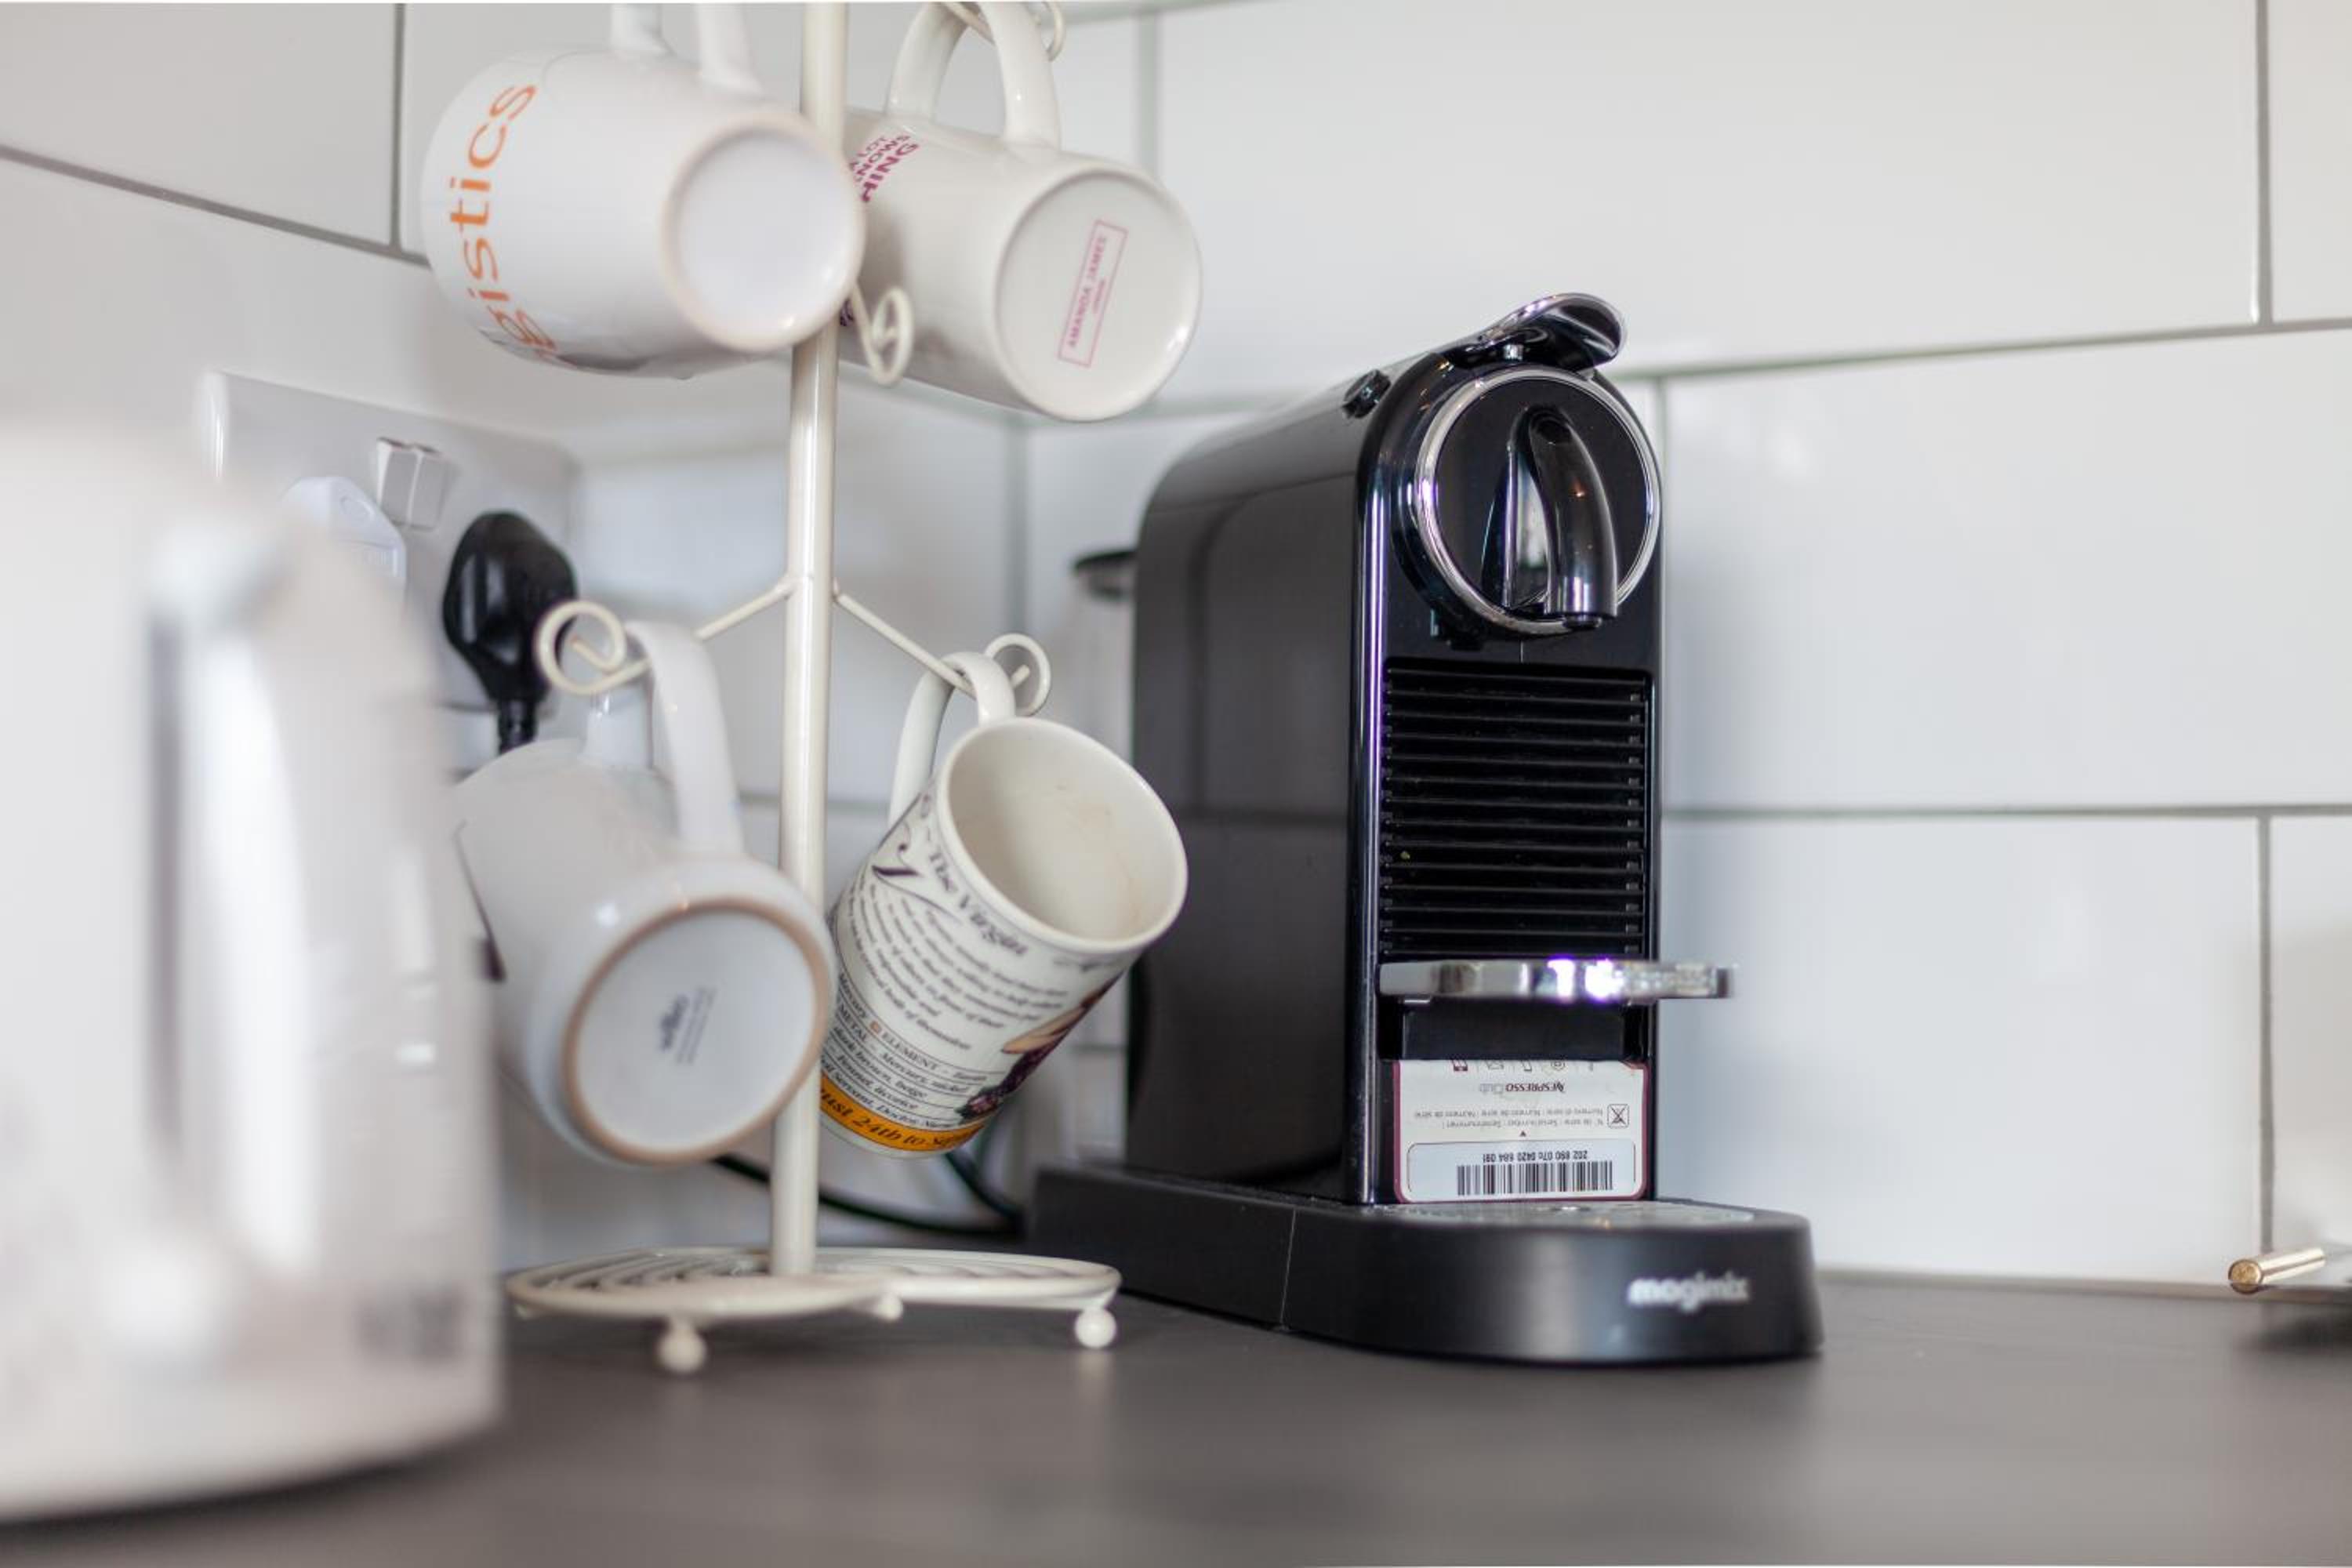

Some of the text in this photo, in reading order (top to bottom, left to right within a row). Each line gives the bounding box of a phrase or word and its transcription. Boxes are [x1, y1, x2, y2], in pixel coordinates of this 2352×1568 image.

[450, 85, 558, 354] gistics
[958, 895, 1030, 957] Virgin
[1504, 1080, 1565, 1093] NESPRESSO
[852, 1116, 902, 1141] 24th
